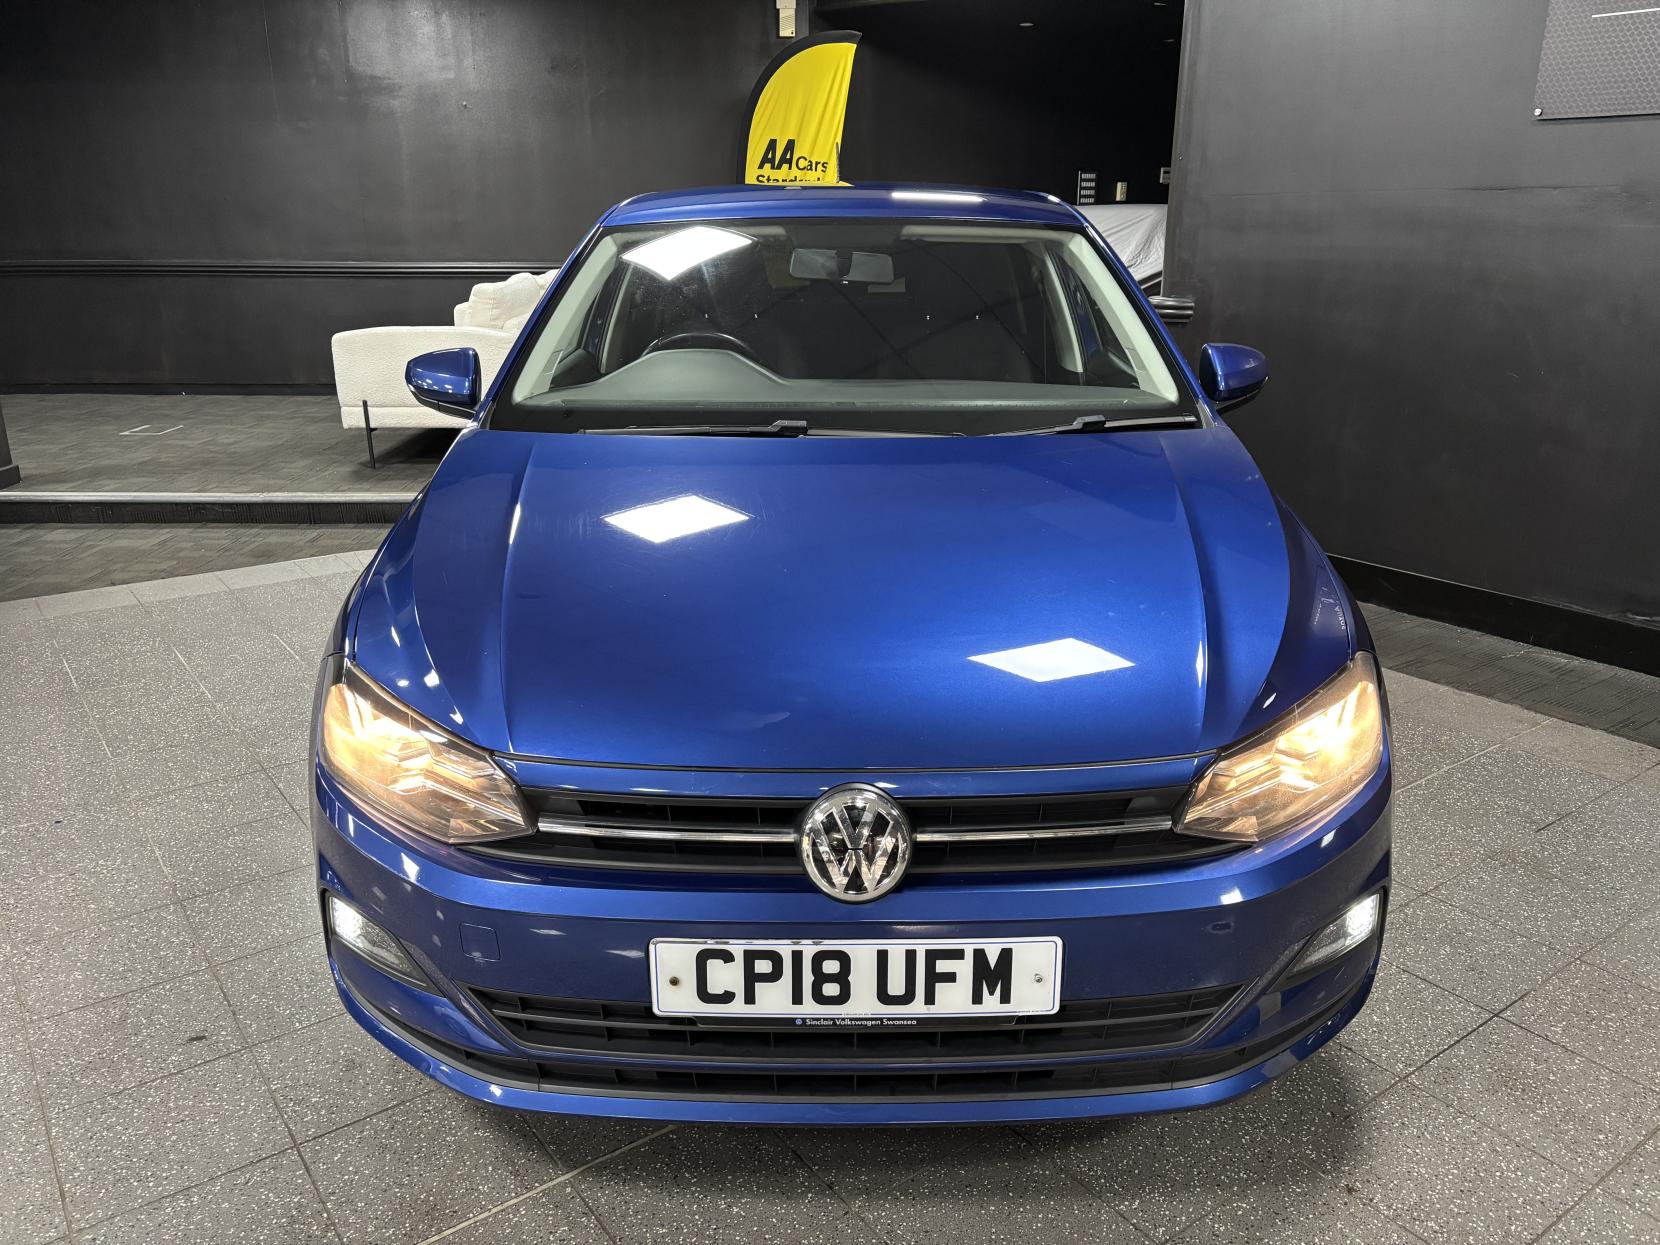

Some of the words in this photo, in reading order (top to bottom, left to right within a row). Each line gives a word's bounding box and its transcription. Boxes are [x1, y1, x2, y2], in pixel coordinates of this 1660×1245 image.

[757, 138, 796, 170] AA
[795, 156, 829, 173] Cars
[695, 948, 852, 1006] CP18
[876, 947, 1014, 1006] UFM
[805, 1018, 834, 1026] Sinclair
[835, 1018, 881, 1027] Volkswagen
[882, 1018, 917, 1026] Swansea
